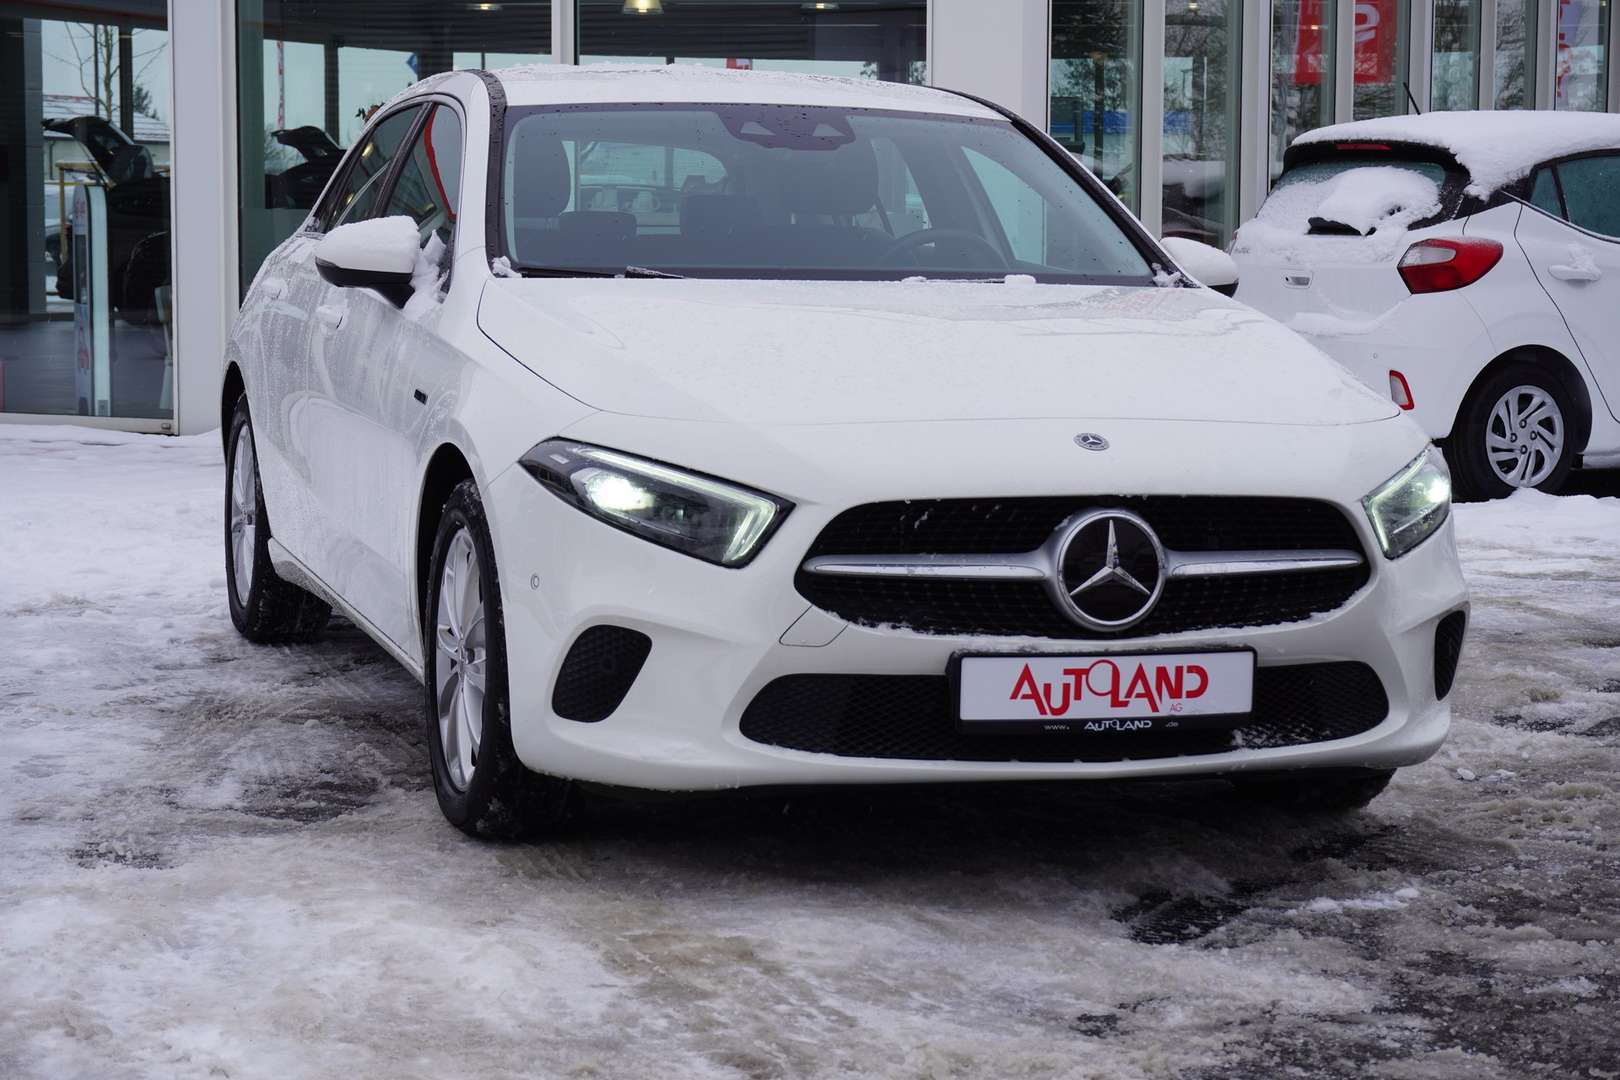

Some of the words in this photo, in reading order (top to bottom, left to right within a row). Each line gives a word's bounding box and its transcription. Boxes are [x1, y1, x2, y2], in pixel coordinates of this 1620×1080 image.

[1009, 659, 1209, 717] AUTOLAND
[1170, 702, 1184, 712] AG
[1084, 719, 1152, 731] AUTOLAND
